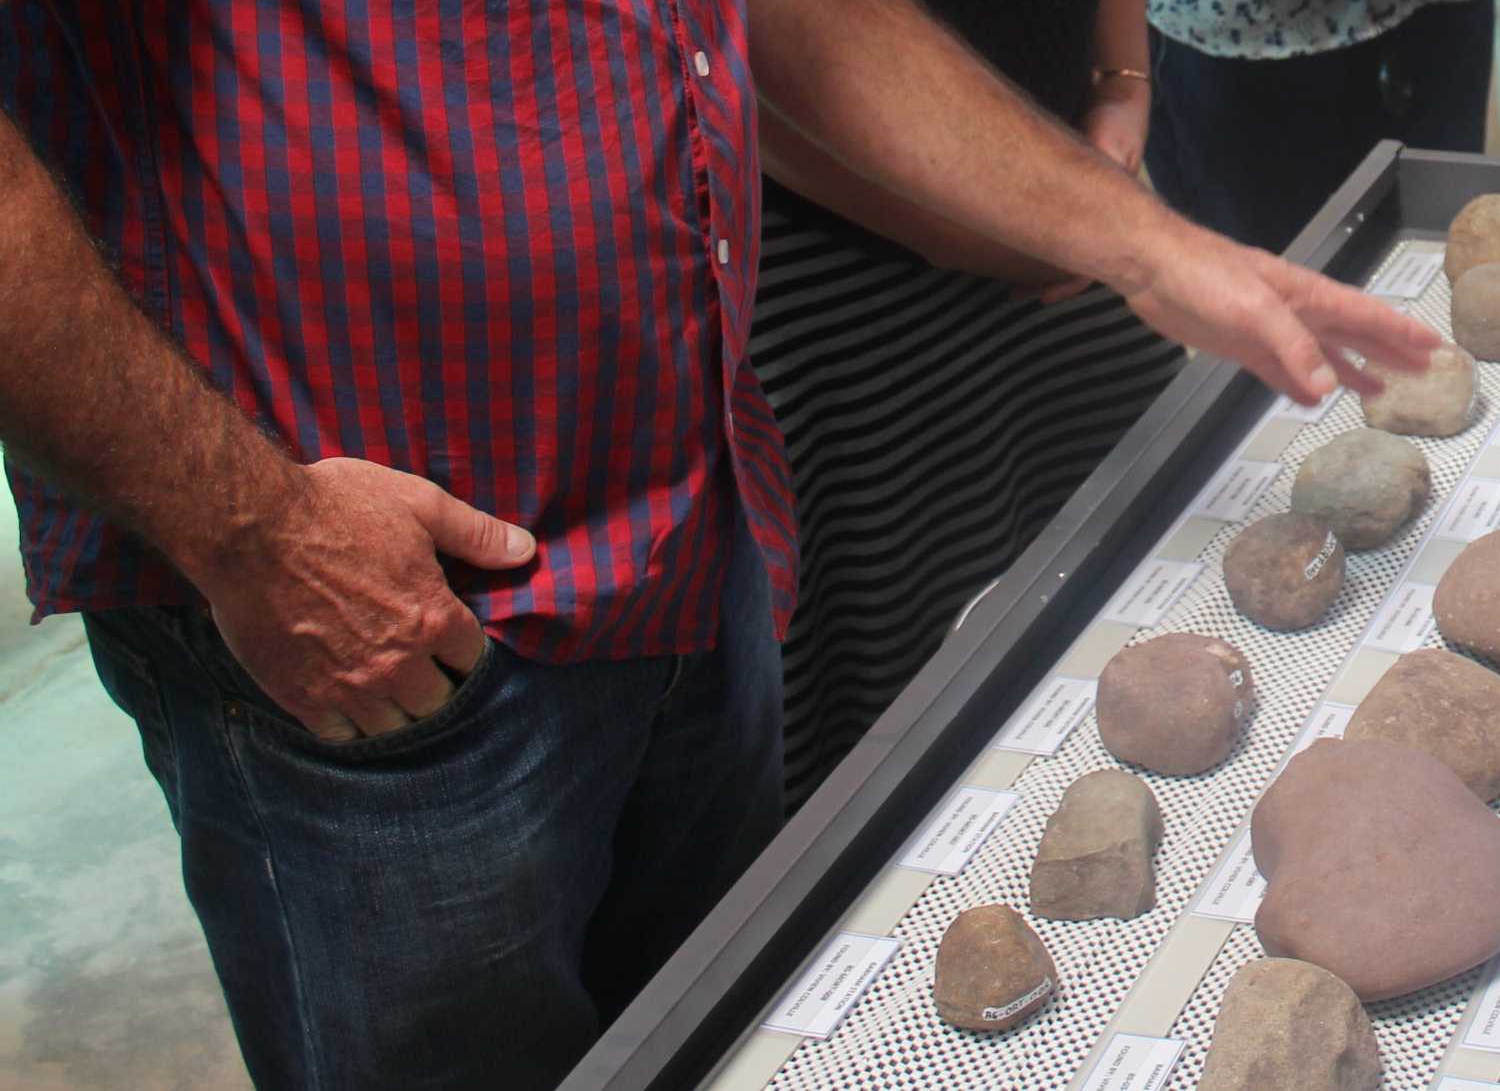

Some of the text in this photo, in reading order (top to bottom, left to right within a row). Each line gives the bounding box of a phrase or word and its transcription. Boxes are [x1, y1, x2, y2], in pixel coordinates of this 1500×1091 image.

[829, 945, 850, 962] FOUND
[806, 974, 825, 990] VIVIEN
[834, 962, 877, 1010] BARHAM STATION
[784, 992, 810, 1015] COLVILLE
[1482, 1010, 1499, 1034] COLVILLE
[1108, 1046, 1133, 1065] FOUND
[1139, 1064, 1165, 1089] BARHAM
